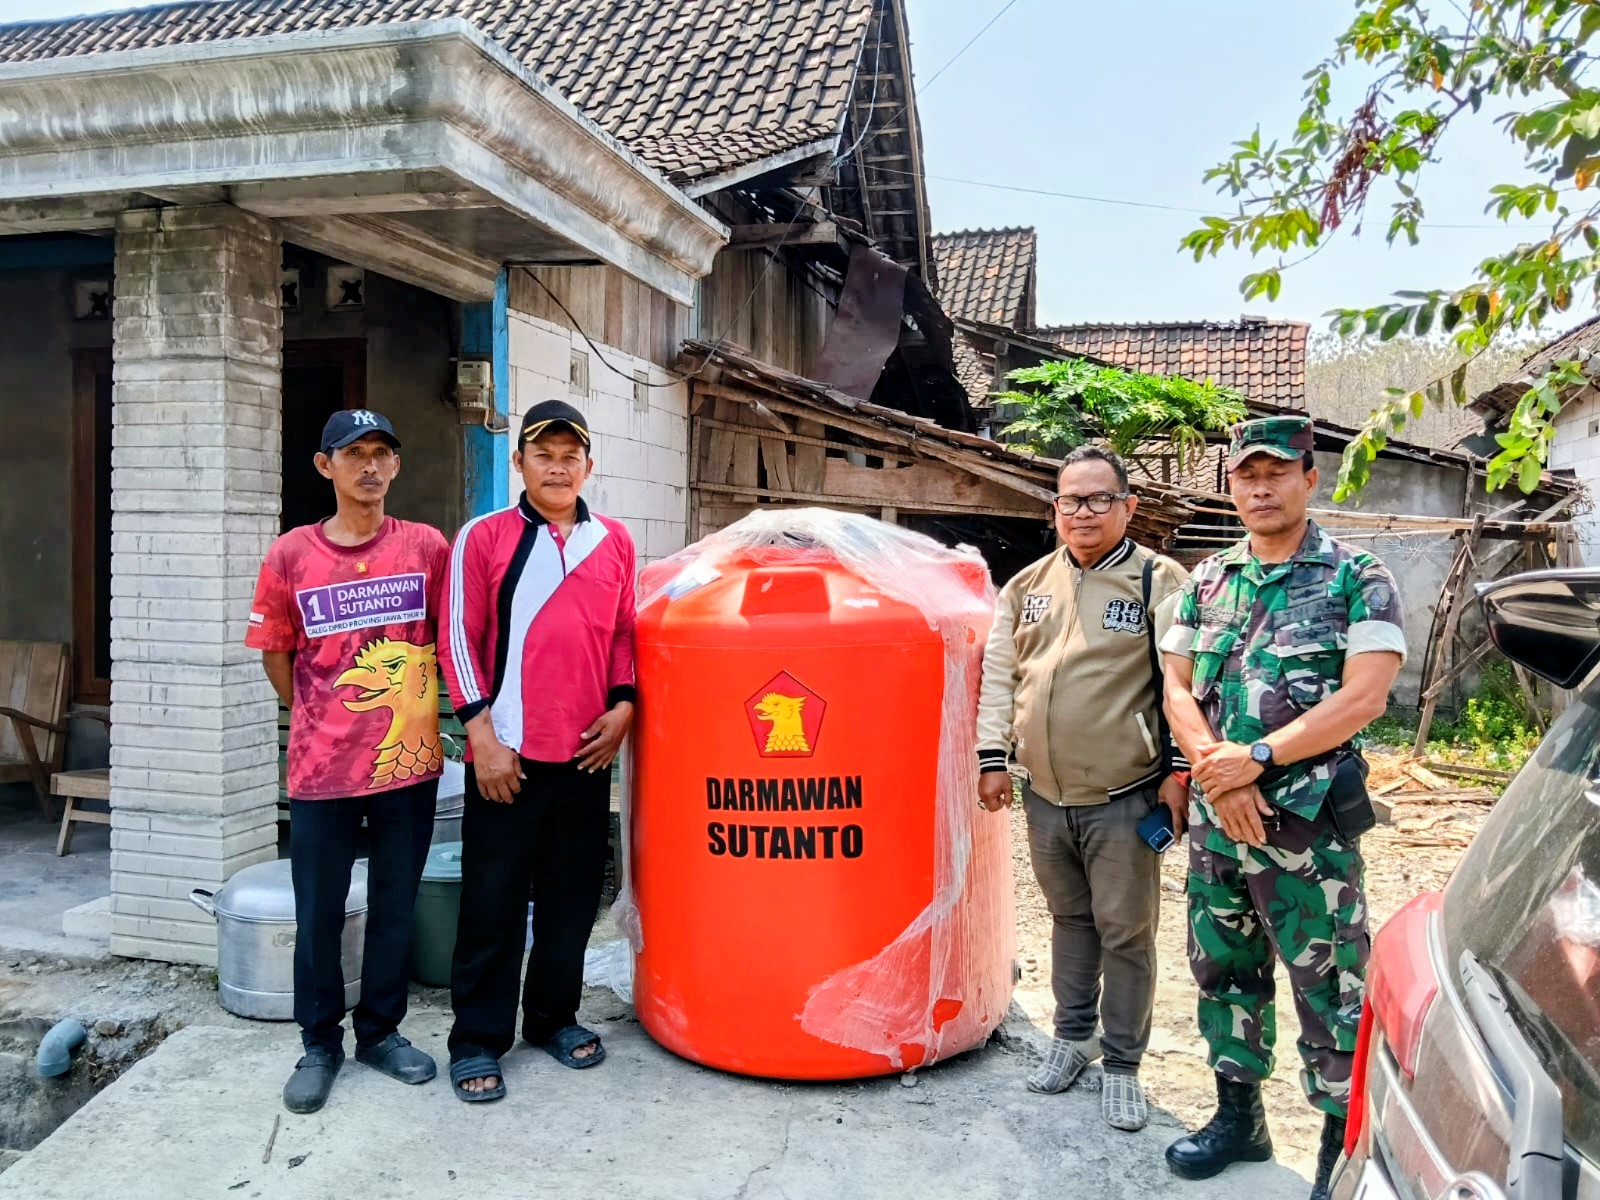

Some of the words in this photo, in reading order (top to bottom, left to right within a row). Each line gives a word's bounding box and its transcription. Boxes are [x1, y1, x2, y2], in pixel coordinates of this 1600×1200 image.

[337, 579, 419, 602] DARMAWAN
[307, 594, 326, 622] 1
[339, 596, 402, 616] SUTANTO
[307, 625, 328, 636] CALEG
[328, 621, 348, 632] DPRD
[349, 616, 382, 629] PROVINSI
[382, 613, 402, 623] JAWA
[706, 776, 862, 811] DARMAWAN
[708, 822, 863, 859] SUTANTO
